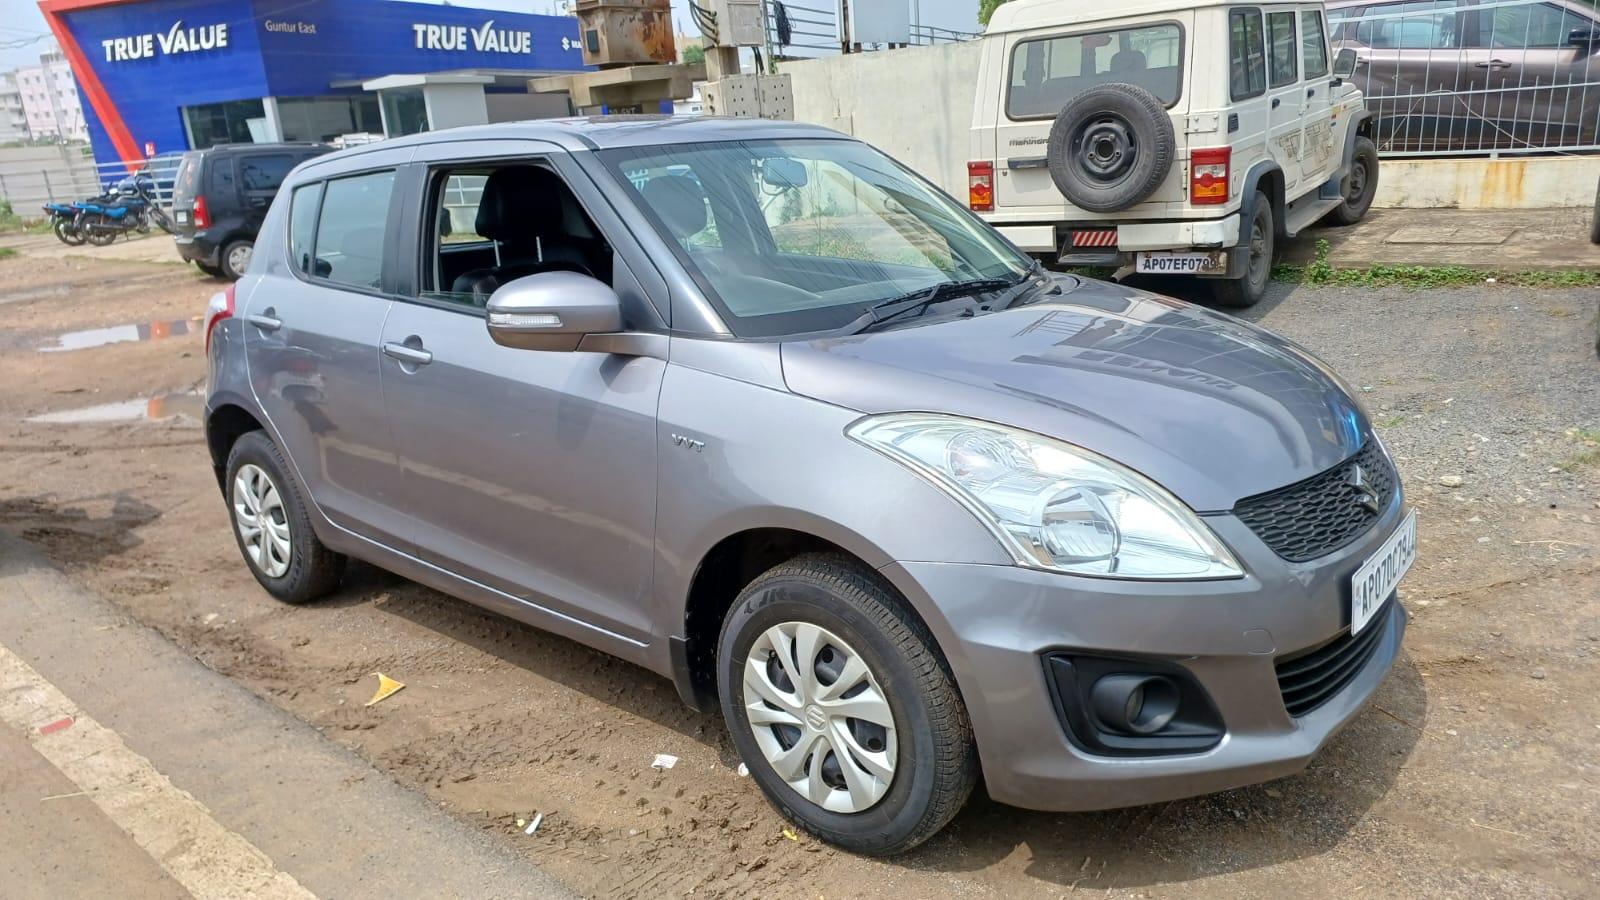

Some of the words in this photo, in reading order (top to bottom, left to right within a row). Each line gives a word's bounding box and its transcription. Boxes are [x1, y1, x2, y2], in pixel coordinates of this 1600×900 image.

[264, 20, 296, 32] Guntur
[297, 21, 317, 34] East
[412, 23, 467, 50] TRUE
[470, 20, 531, 53] VALUE
[102, 34, 154, 62] TRUE
[157, 20, 227, 54] VALUE
[671, 433, 705, 453] VVT
